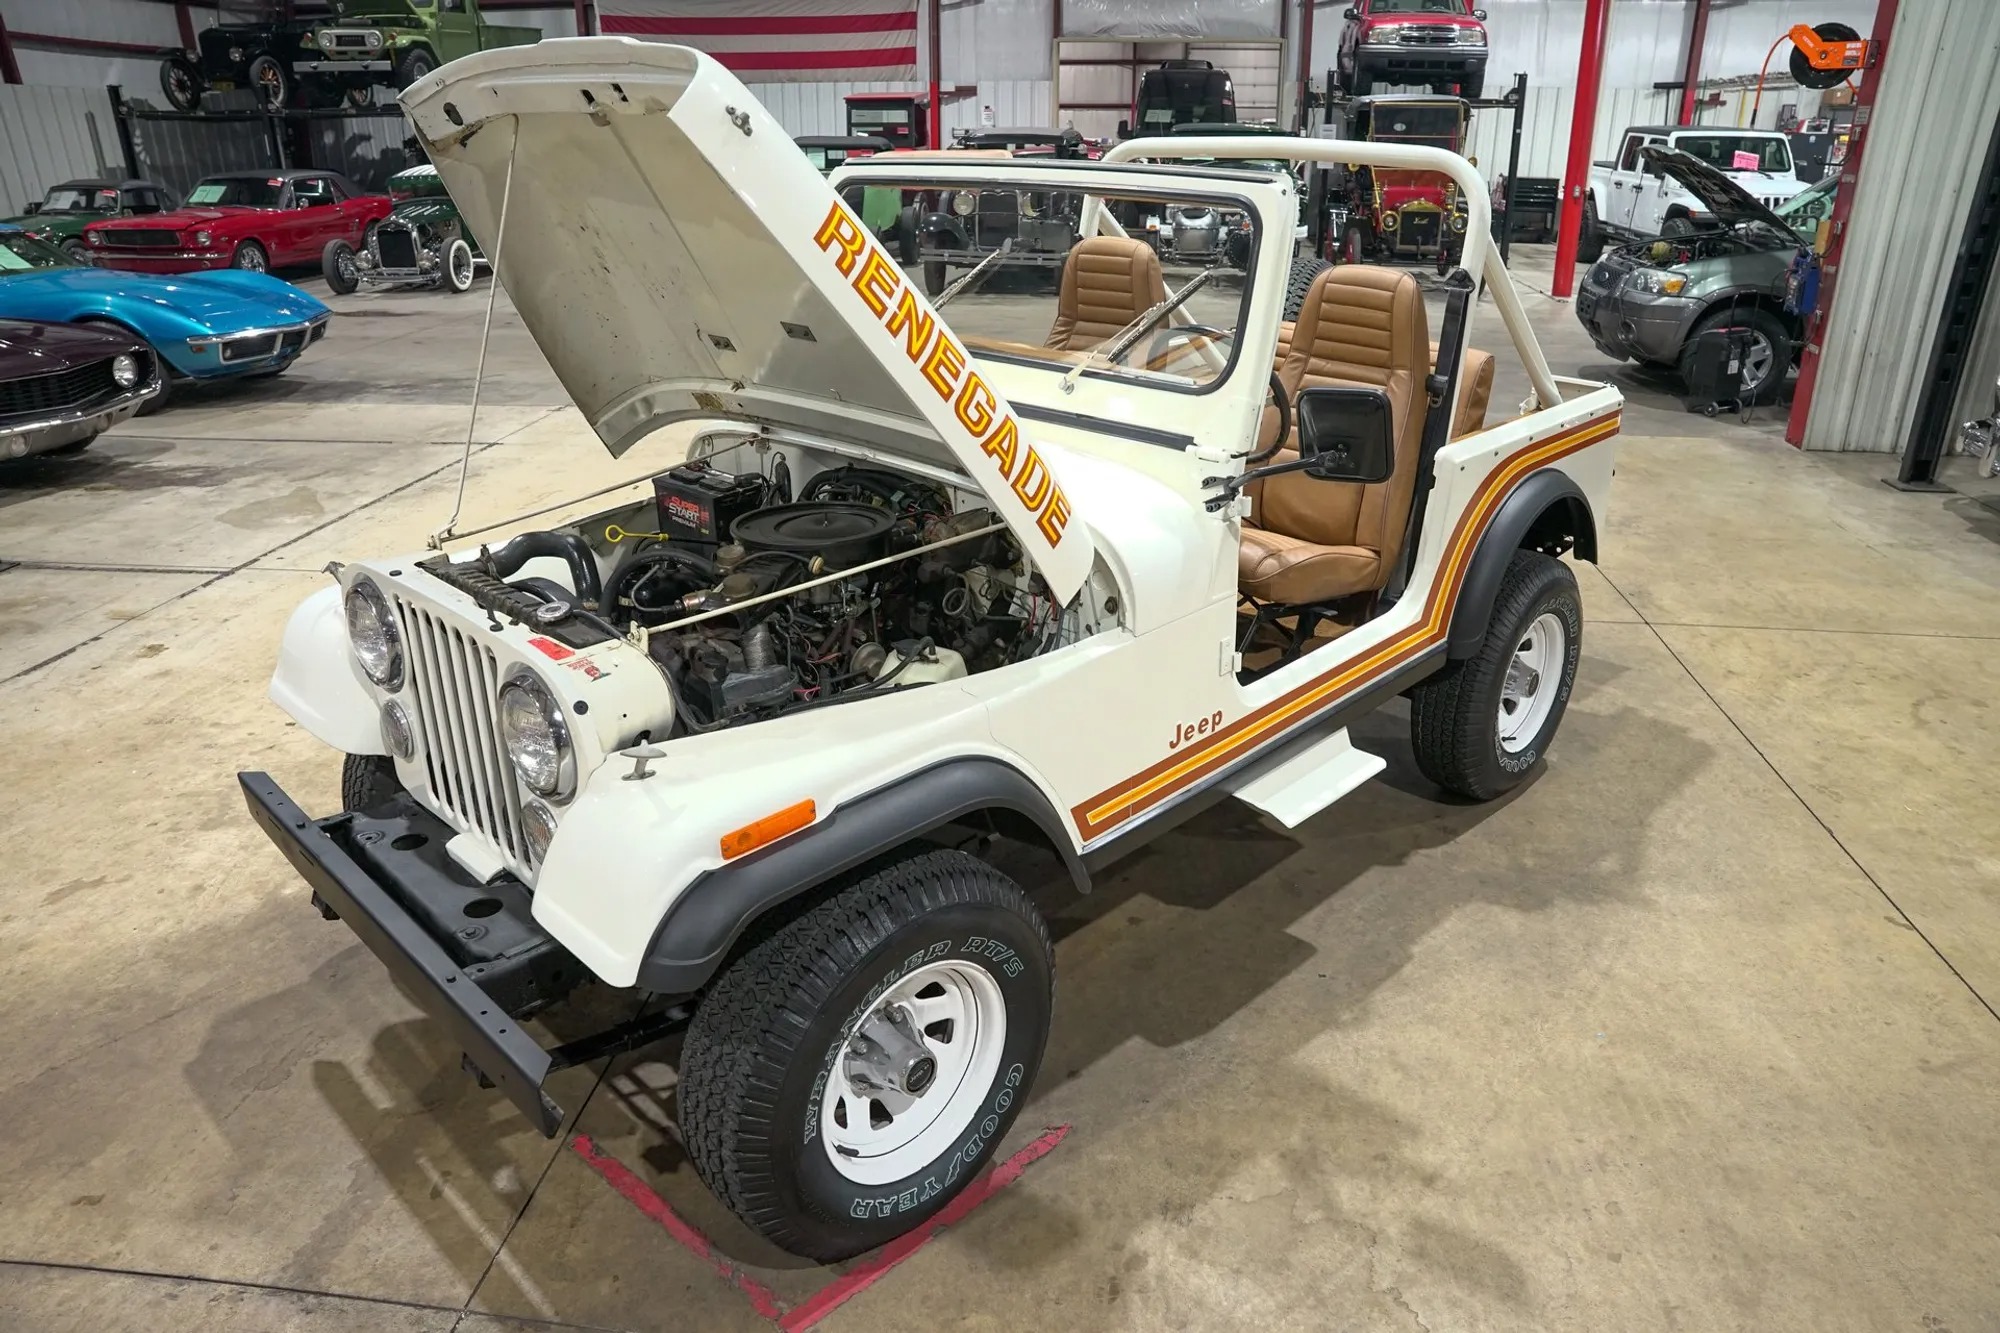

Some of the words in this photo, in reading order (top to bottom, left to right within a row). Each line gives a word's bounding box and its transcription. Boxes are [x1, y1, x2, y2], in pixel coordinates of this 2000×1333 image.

[813, 200, 1071, 549] RENEGADE
[668, 502, 700, 521] START
[671, 496, 700, 513] SUPER
[1169, 710, 1223, 749] Jeep
[961, 936, 1024, 978] RT/S
